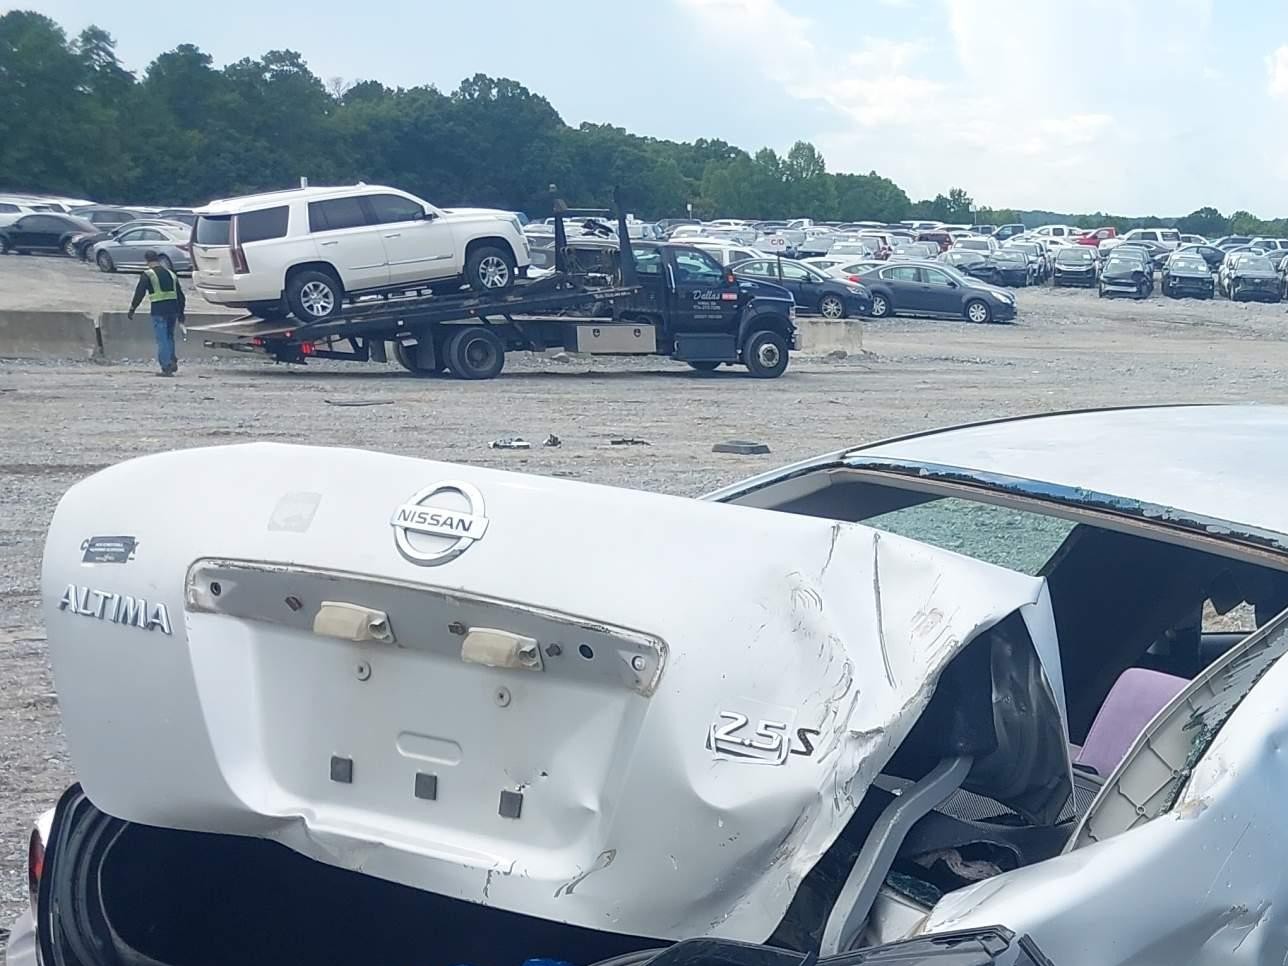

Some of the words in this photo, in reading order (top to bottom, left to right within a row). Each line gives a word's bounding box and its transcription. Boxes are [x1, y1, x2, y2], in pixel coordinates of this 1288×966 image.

[692, 289, 720, 300] Dallas
[397, 508, 473, 532] NISSAN
[58, 583, 172, 635] ALTIMA
